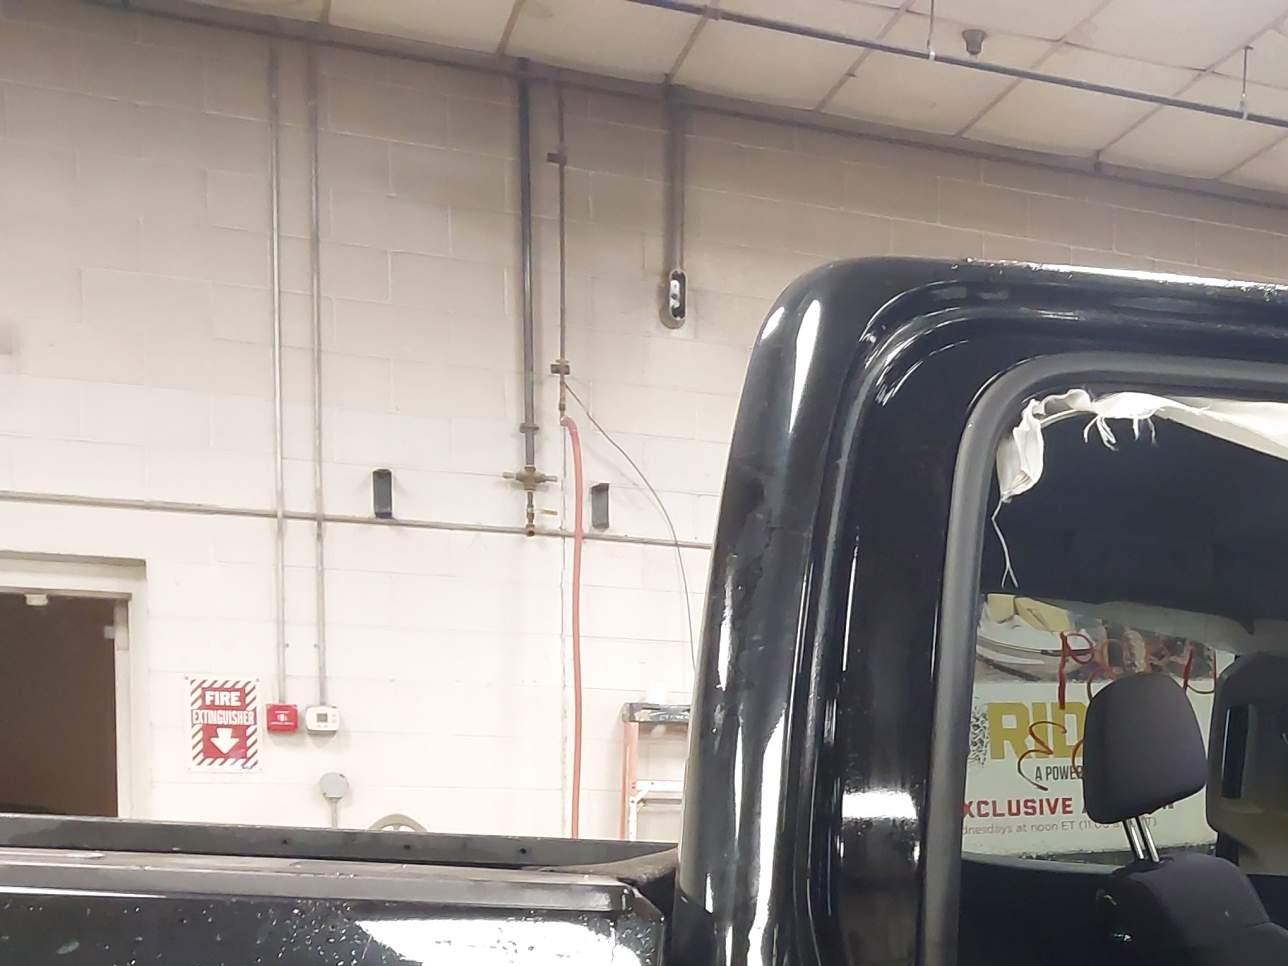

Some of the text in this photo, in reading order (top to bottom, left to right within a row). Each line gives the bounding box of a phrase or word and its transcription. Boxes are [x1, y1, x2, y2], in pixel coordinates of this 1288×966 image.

[204, 690, 242, 707] FIRE
[192, 709, 255, 726] EXTINGUISHER
[1035, 765, 1043, 780] A
[1030, 822, 1059, 833] noon
[1061, 820, 1075, 831] ET
